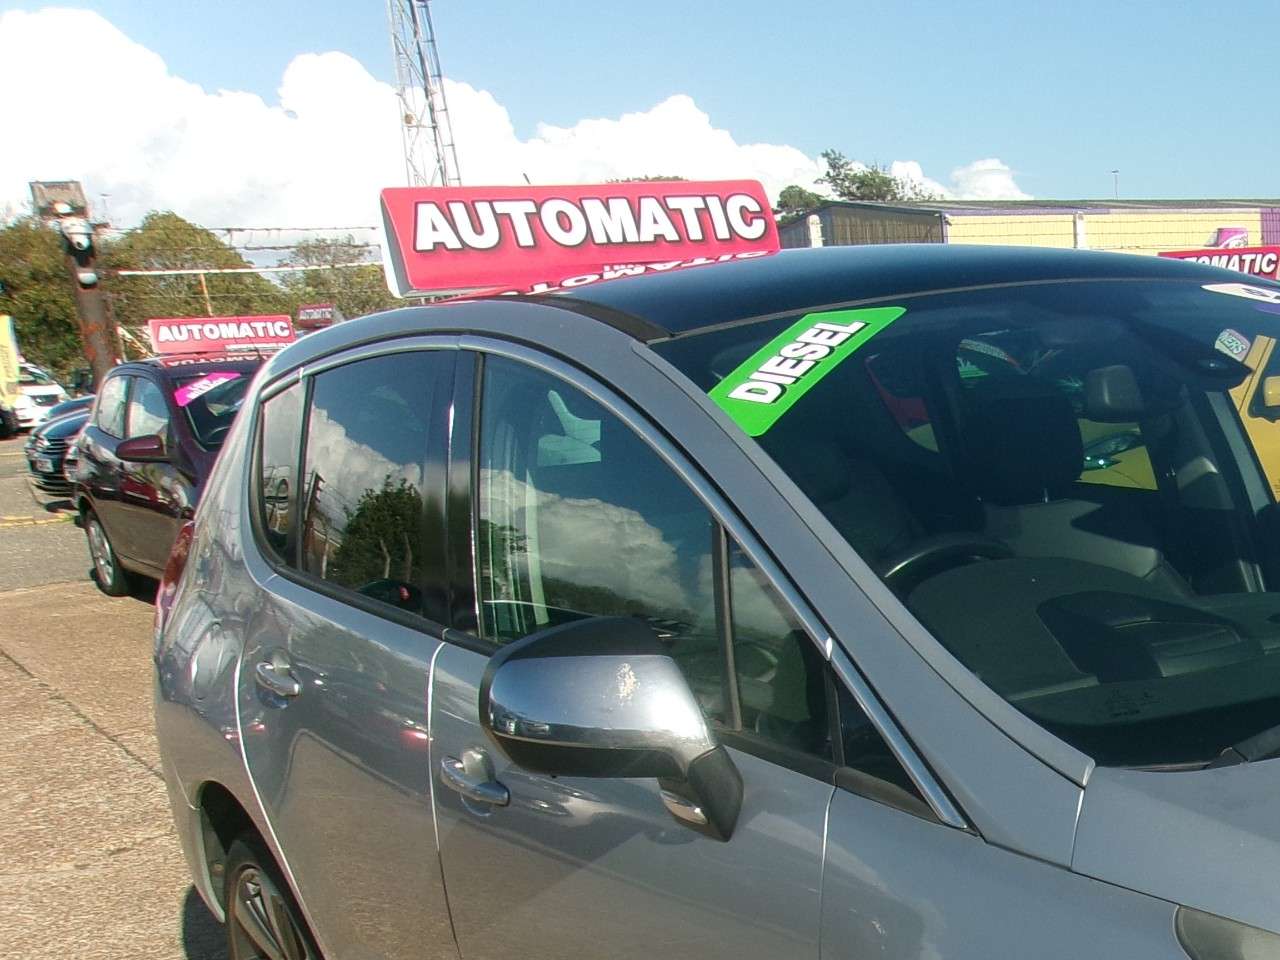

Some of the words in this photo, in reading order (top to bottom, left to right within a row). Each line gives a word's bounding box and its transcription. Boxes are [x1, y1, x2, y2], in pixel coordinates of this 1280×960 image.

[415, 194, 768, 252] AUTOMATIC
[1183, 253, 1277, 274] MATIC
[158, 321, 290, 342] AUTOMATIC
[727, 320, 872, 405] DIESEL
